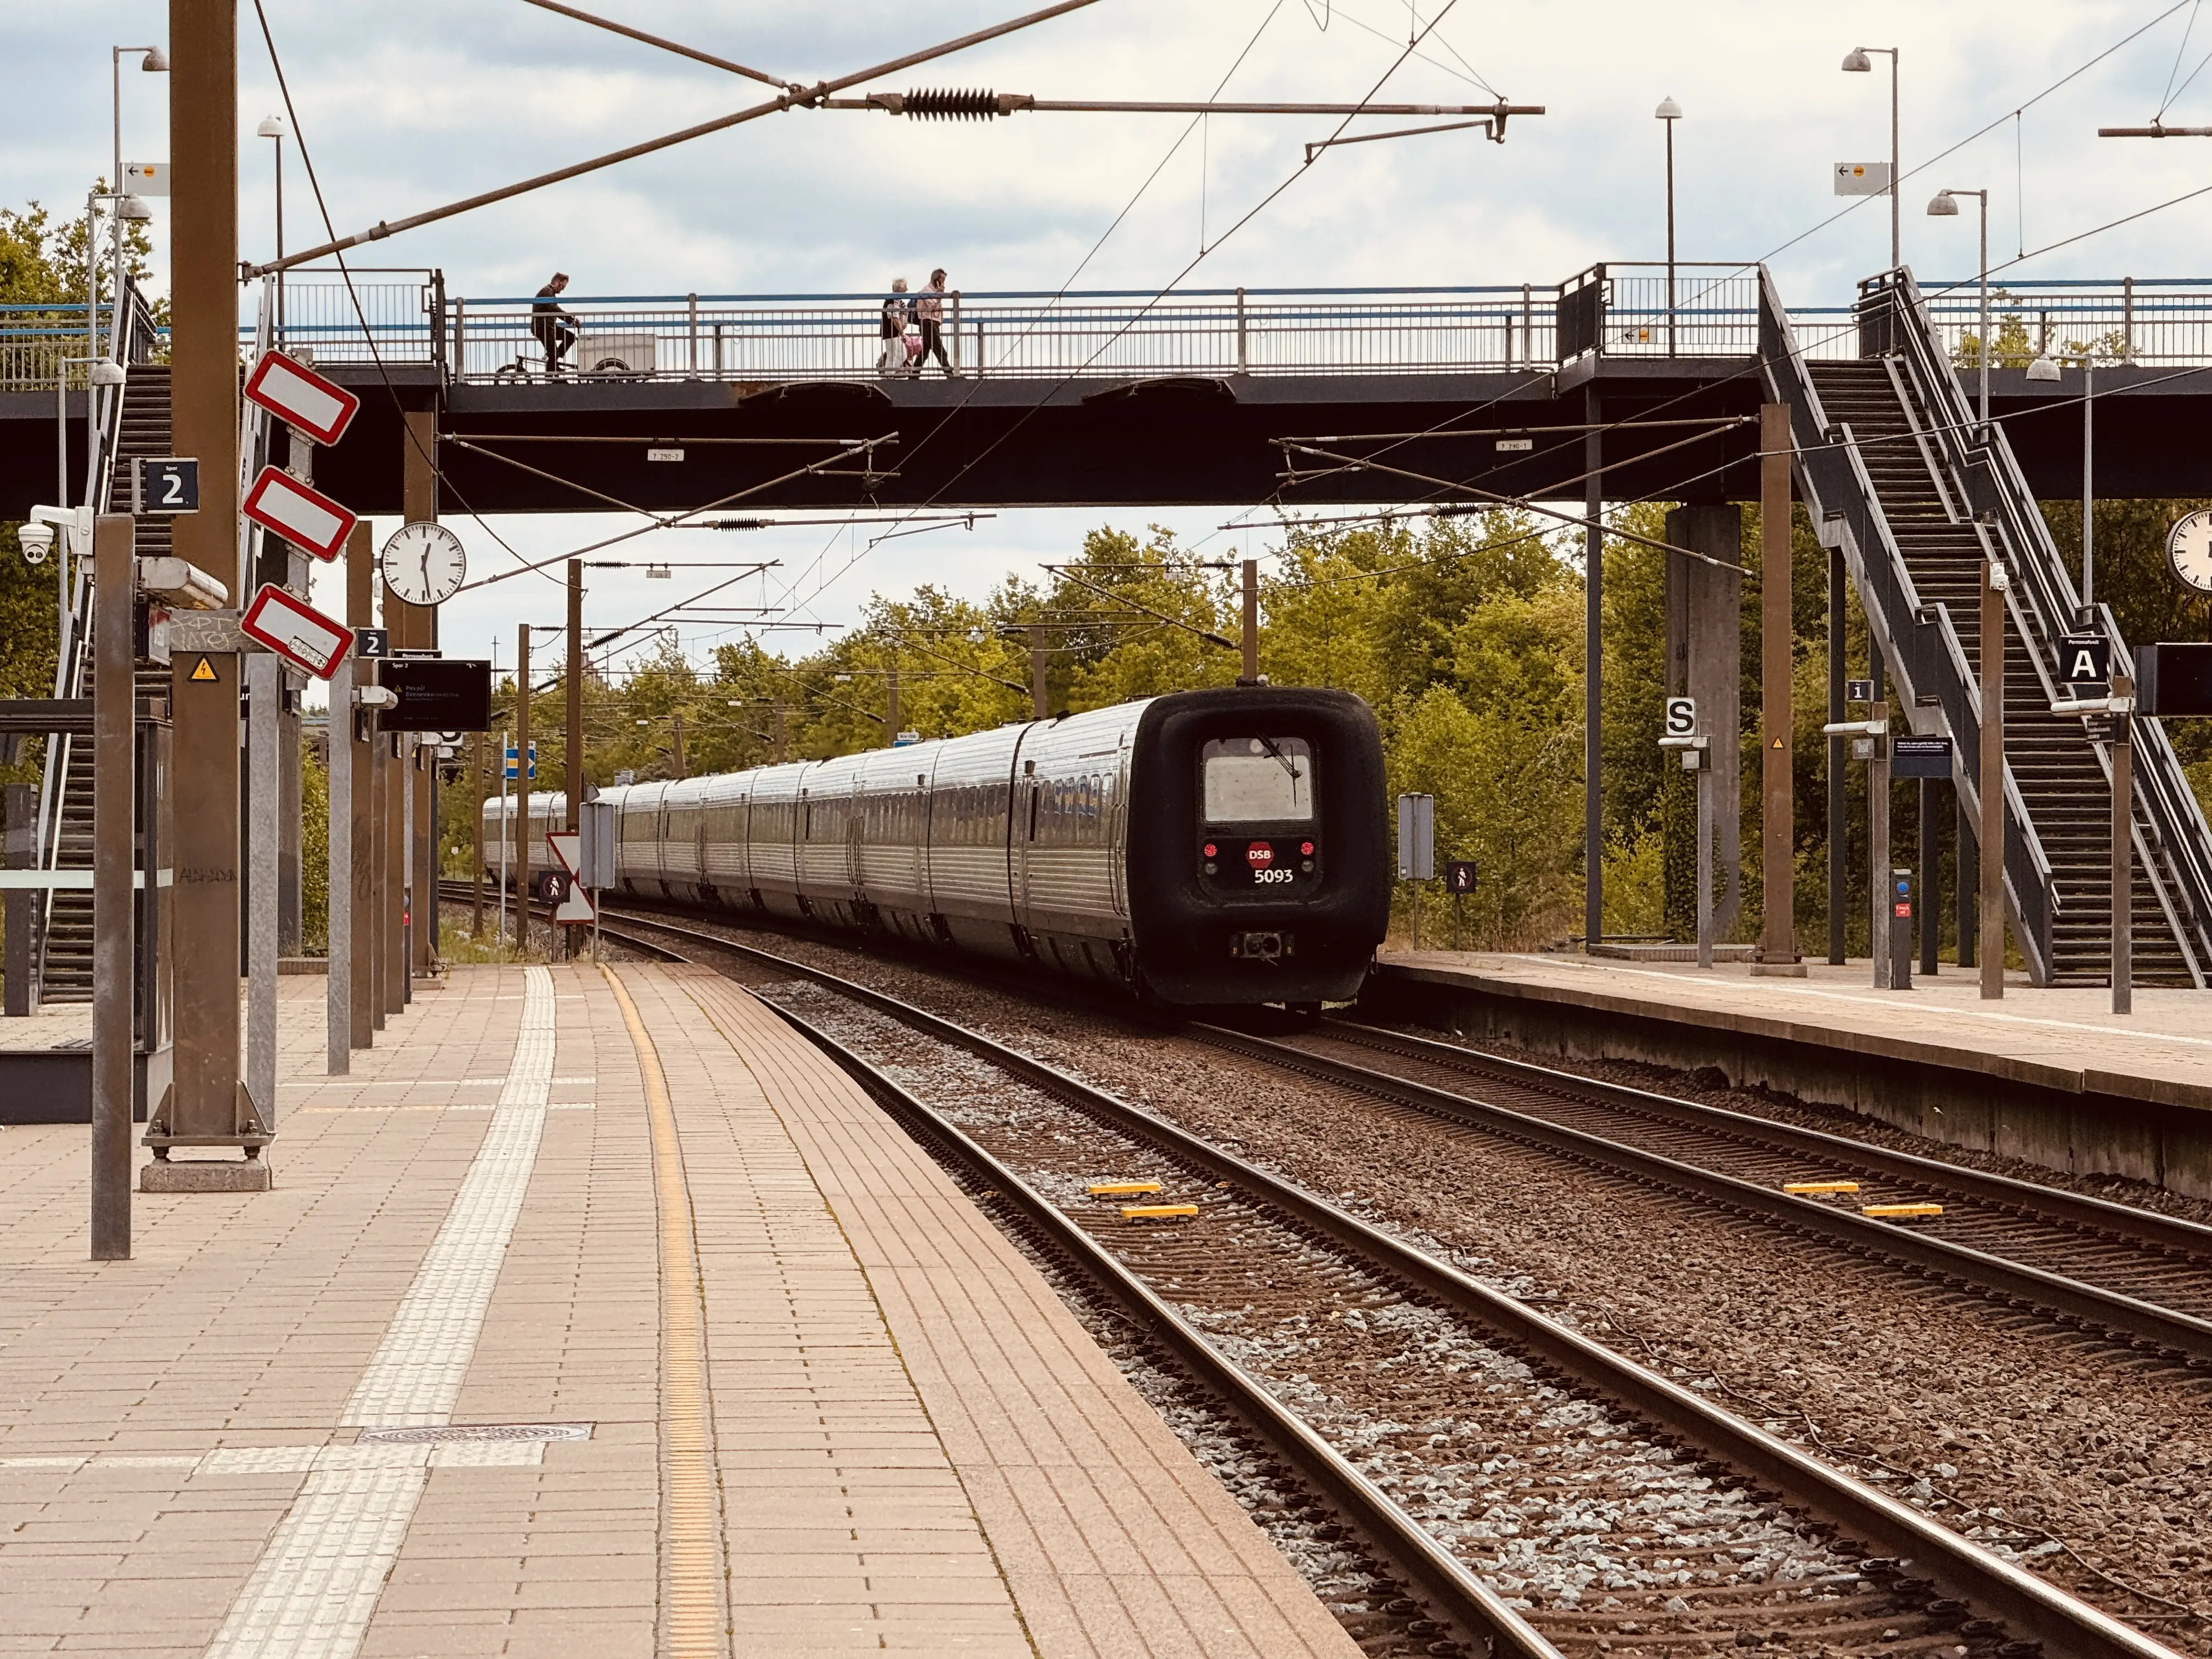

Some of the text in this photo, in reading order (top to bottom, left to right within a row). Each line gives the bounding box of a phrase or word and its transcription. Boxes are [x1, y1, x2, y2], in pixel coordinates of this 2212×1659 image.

[162, 475, 183, 504] 2
[367, 636, 379, 653] 2
[2072, 650, 2097, 678] A
[1854, 686, 1863, 698] 1
[1668, 701, 1694, 732] S
[1249, 850, 1271, 860] DSB
[1255, 869, 1294, 883] 5093
